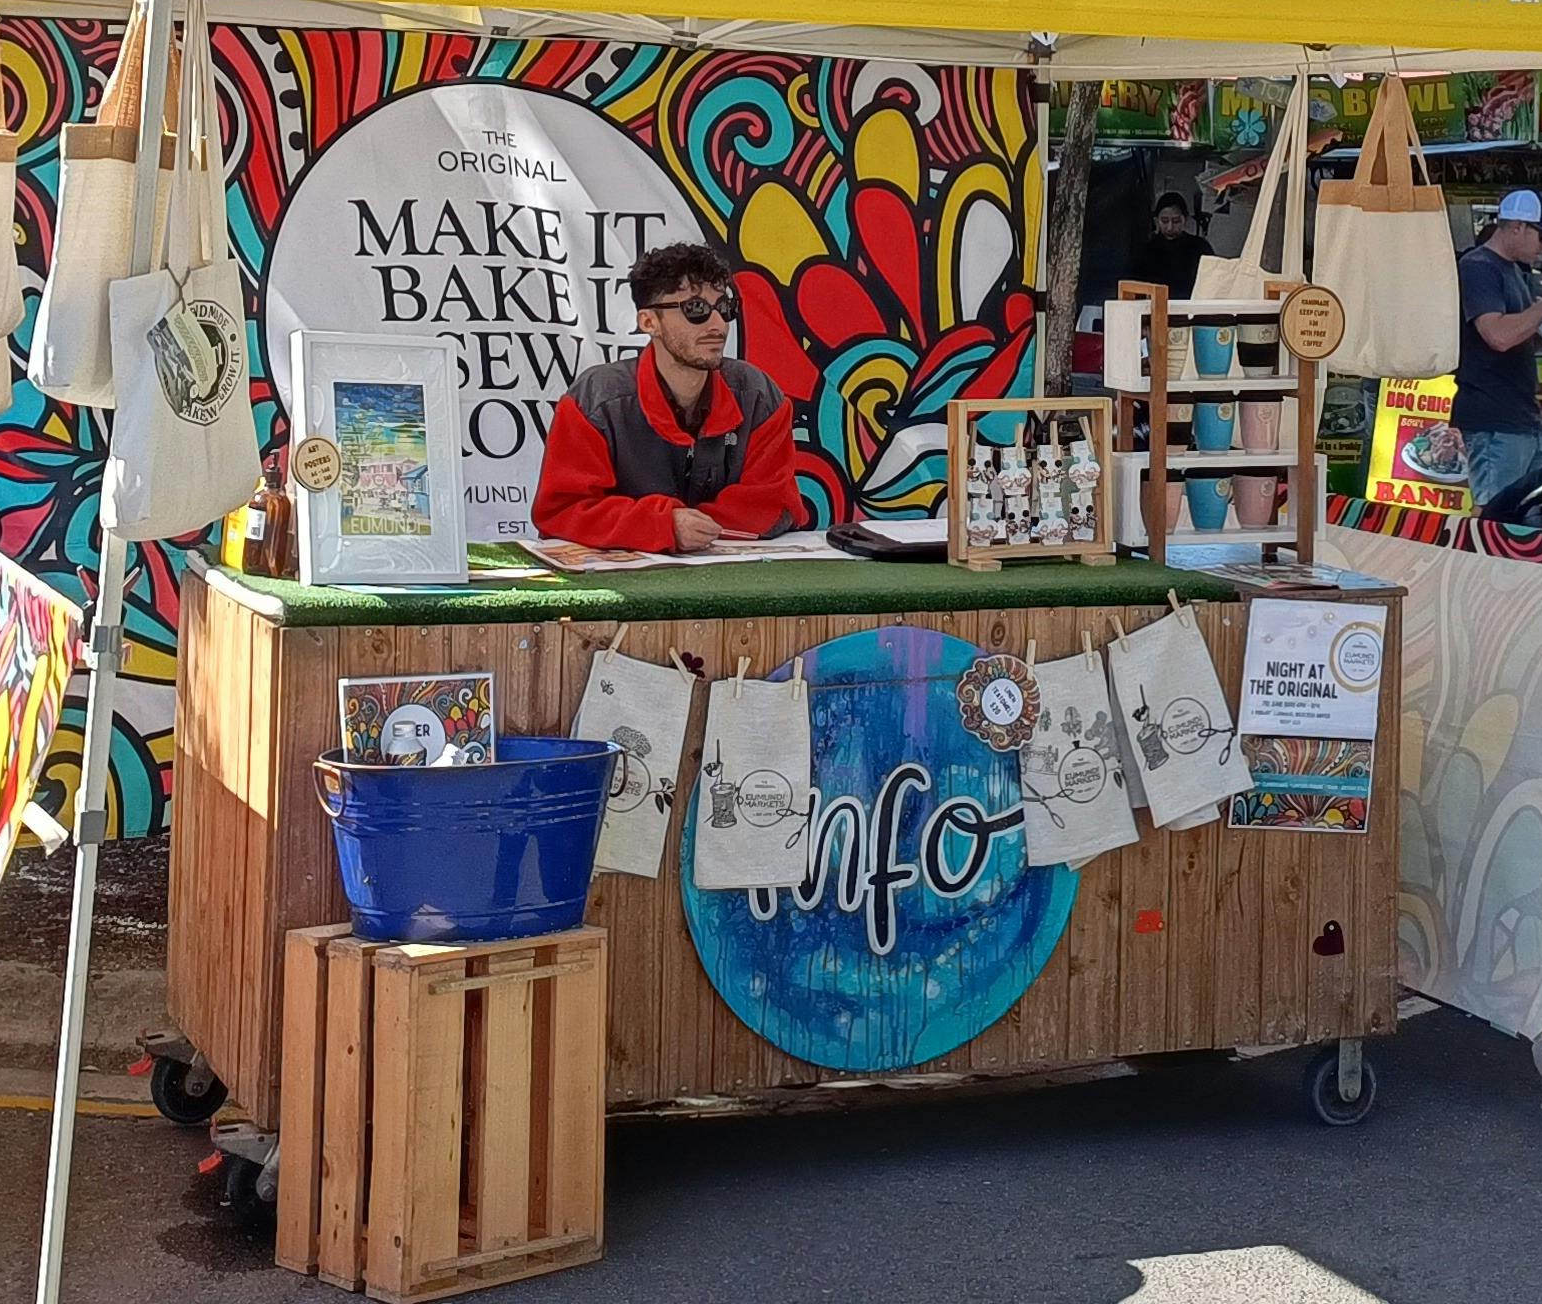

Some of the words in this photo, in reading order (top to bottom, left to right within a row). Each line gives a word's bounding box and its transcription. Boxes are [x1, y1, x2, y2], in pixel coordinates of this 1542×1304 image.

[1101, 80, 1163, 117] FRY
[482, 130, 516, 148] THE
[437, 150, 567, 182] ORIGINAL
[347, 199, 568, 260] MAKE
[585, 210, 667, 269] IT
[371, 264, 579, 326] BAKE
[1386, 391, 1414, 411] BBQ
[1417, 394, 1451, 413] CHIC
[304, 455, 331, 469] POSTERS
[1375, 481, 1464, 510] BANH
[350, 517, 423, 535] EUMUNDI
[498, 521, 528, 534] EST
[1266, 661, 1306, 679] NIGHT
[1308, 663, 1326, 680] AT
[1249, 679, 1273, 696] THE
[1277, 680, 1338, 699] ORIGINAL
[416, 723, 431, 737] ER
[749, 763, 1024, 955] nfo
